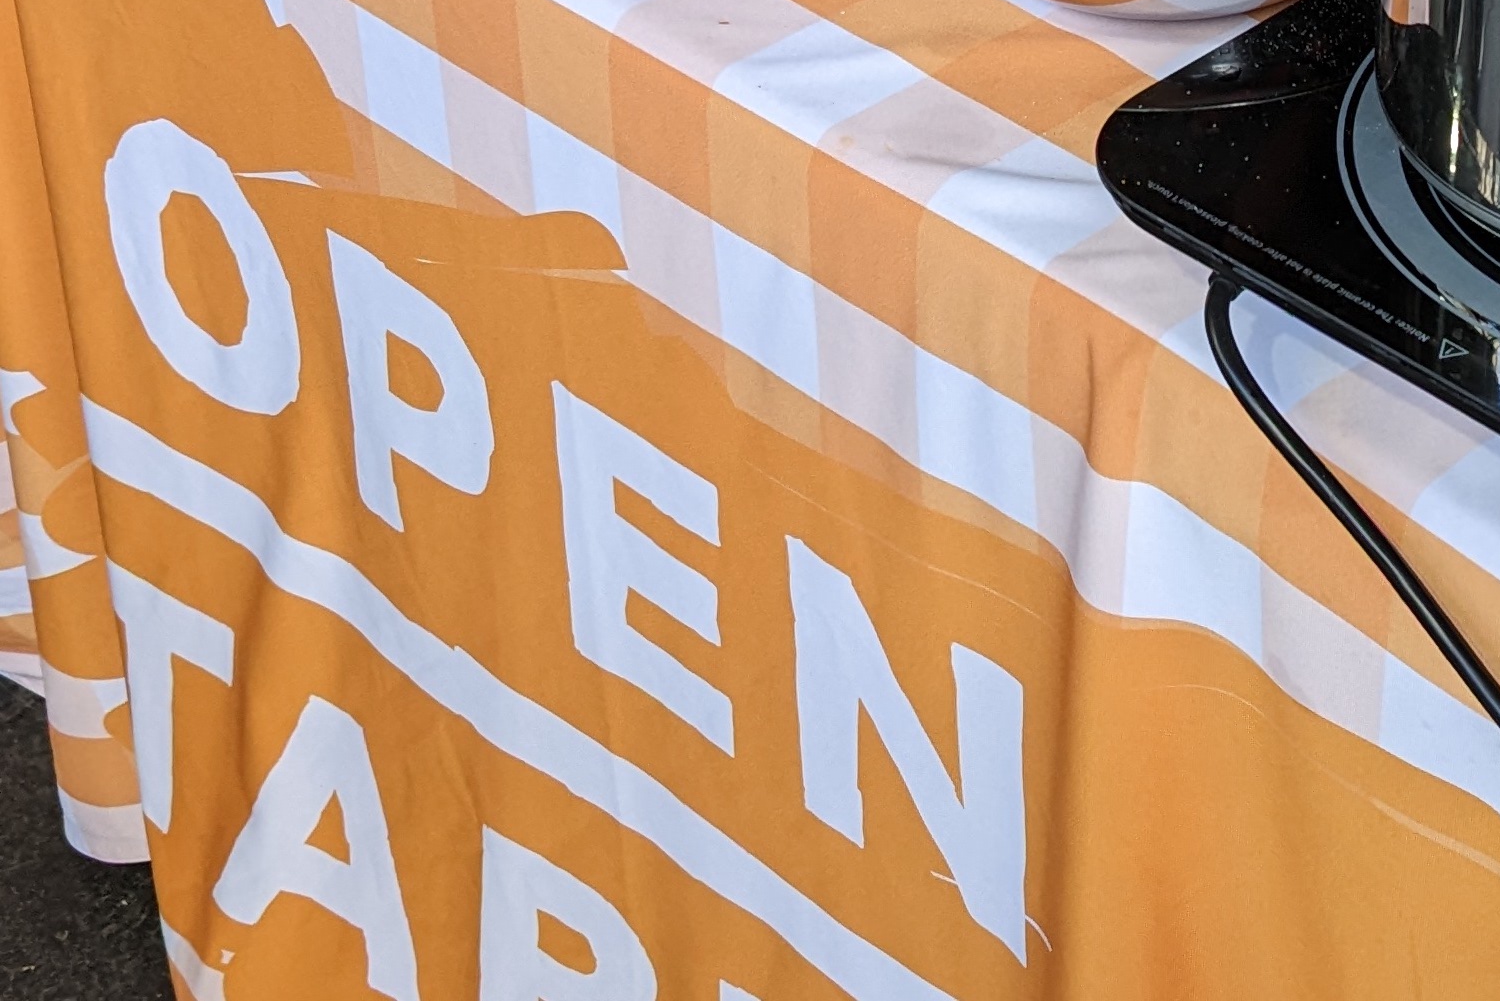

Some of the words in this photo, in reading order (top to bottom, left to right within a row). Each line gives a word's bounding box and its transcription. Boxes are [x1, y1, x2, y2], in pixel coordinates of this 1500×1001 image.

[1262, 244, 1289, 264] after
[1285, 256, 1305, 274] hot
[1312, 269, 1342, 295] plate
[1342, 287, 1375, 313] ceramic
[1375, 307, 1395, 325] The
[1396, 320, 1431, 344] Notice:
[103, 117, 1028, 967] OPEN
